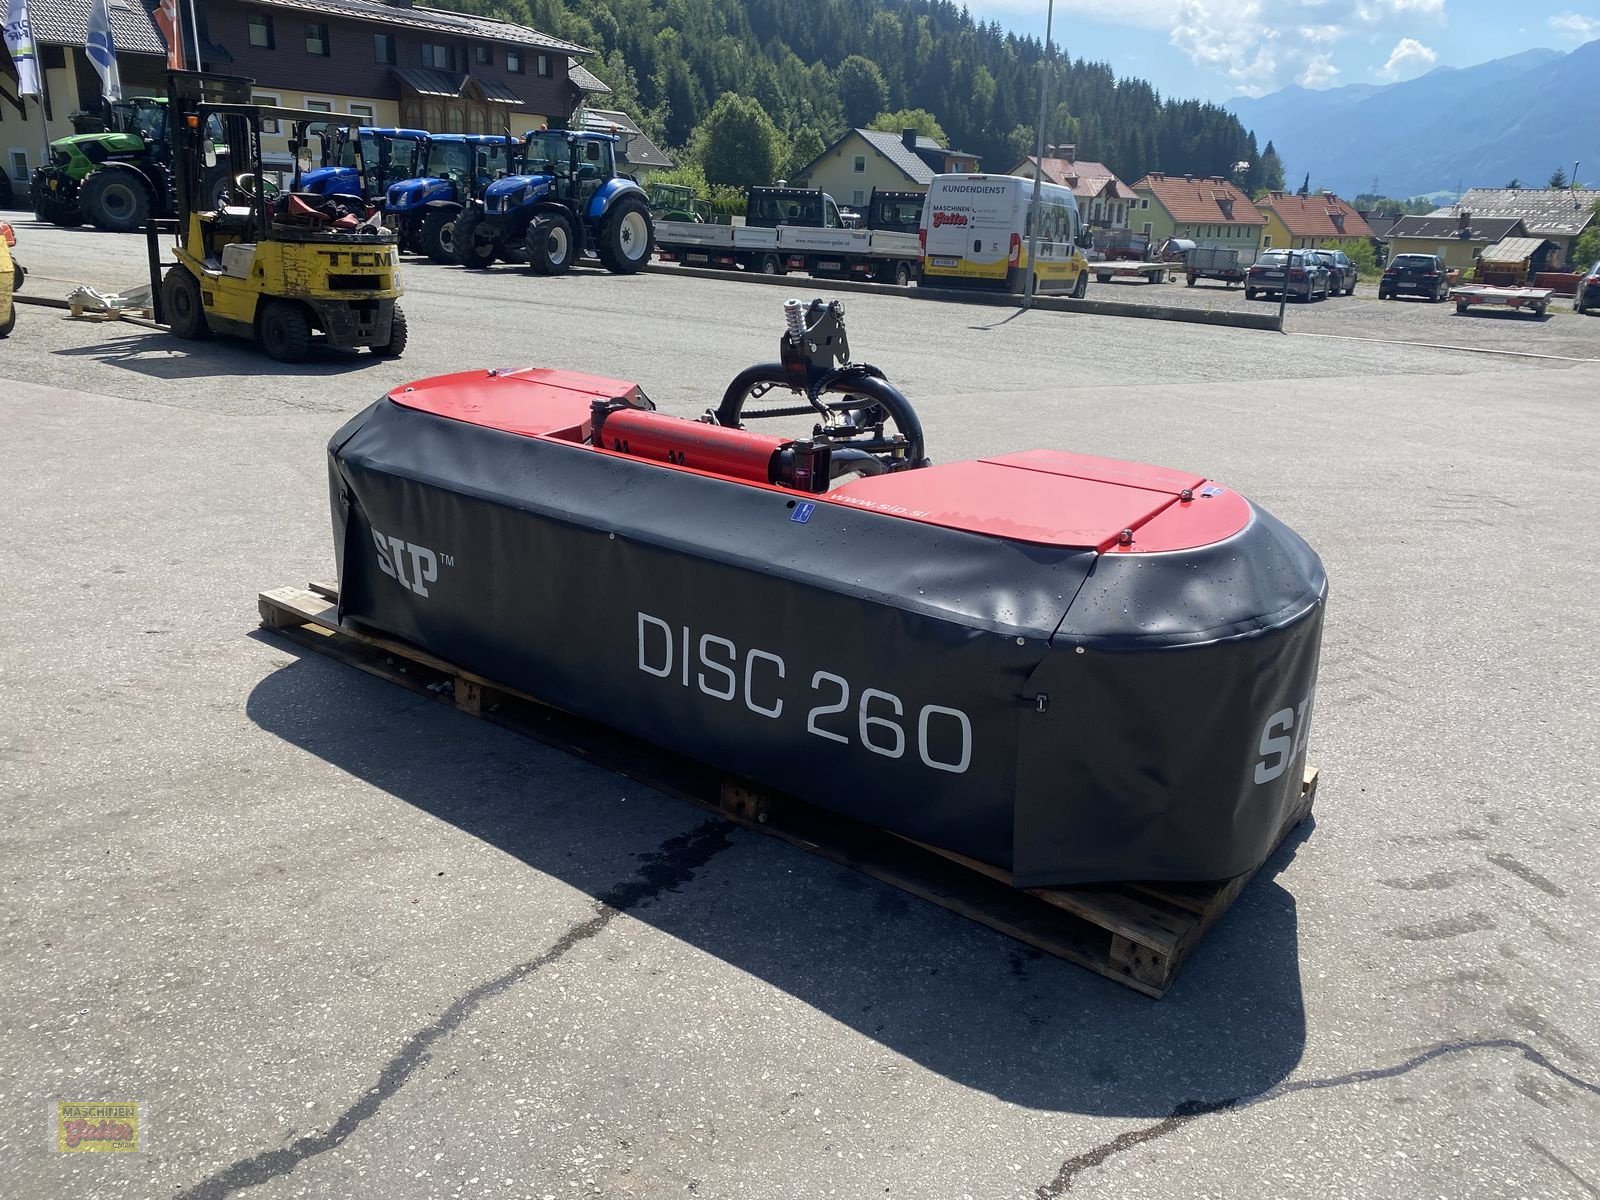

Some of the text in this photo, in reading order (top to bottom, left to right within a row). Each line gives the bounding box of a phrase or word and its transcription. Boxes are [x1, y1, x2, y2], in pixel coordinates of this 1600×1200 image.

[942, 184, 1006, 194] KUNDENDIENST
[317, 250, 392, 267] TCM
[831, 494, 931, 517] www.sip.si
[370, 526, 438, 598] SIP
[637, 611, 973, 774] DISC 260
[1254, 685, 1316, 785] SI
